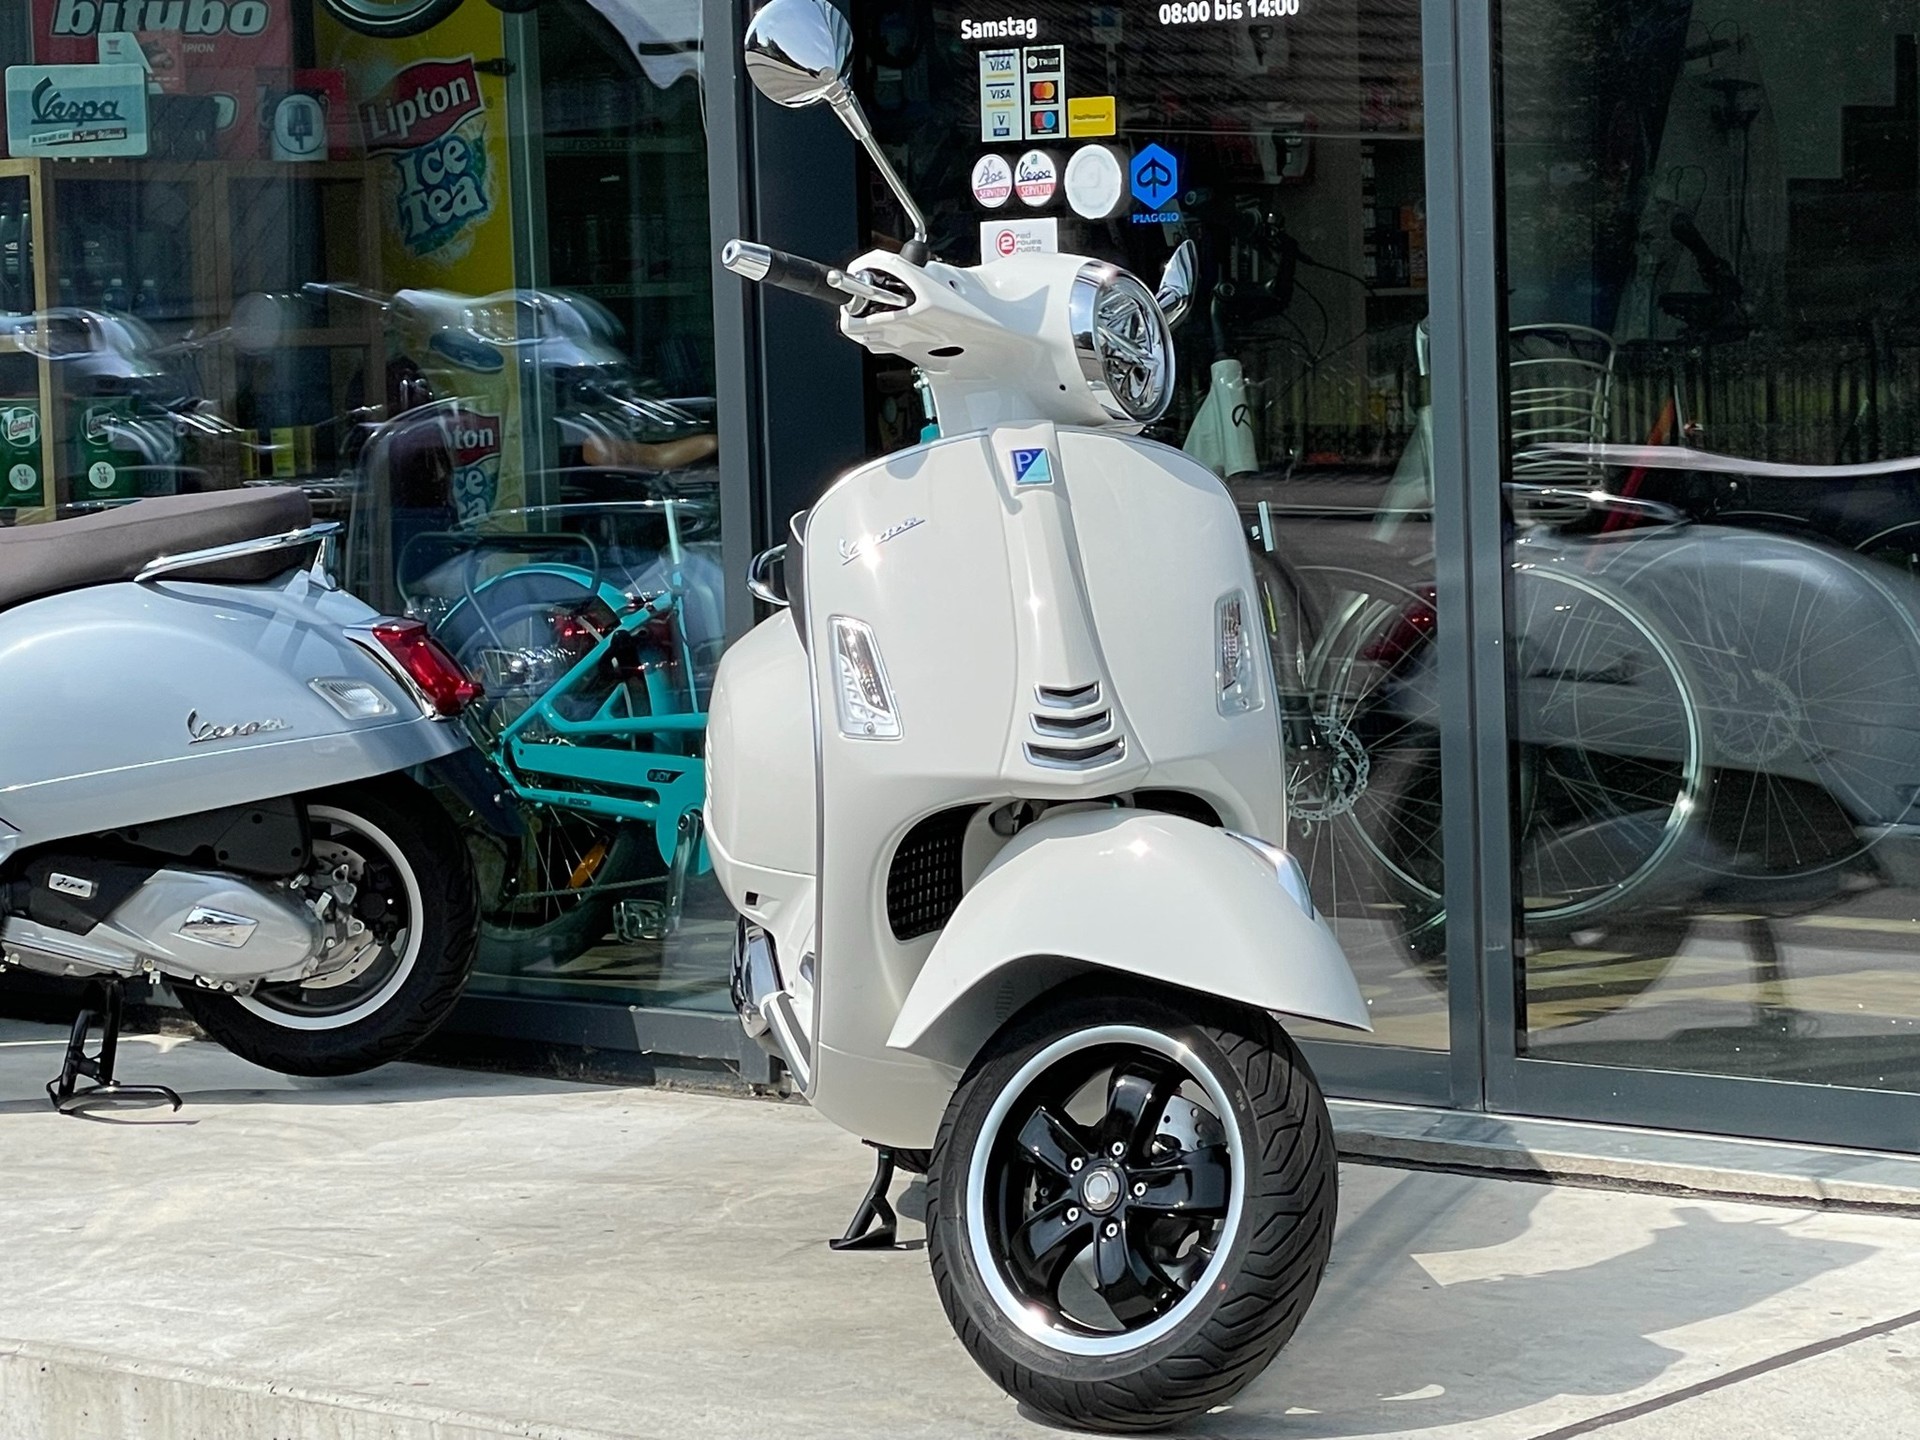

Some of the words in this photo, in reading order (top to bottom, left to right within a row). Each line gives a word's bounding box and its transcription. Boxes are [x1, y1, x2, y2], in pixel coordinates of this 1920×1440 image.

[54, 0, 266, 34] bitubo
[1158, 0, 1210, 25] 08:00
[1214, 0, 1243, 21] bis
[1247, 0, 1299, 18] 14:00
[961, 17, 1037, 39] Samstag
[990, 61, 1011, 71] VISA
[31, 76, 126, 127] Vespa
[990, 89, 1011, 99] VISA
[366, 76, 470, 140] Lipton
[399, 139, 468, 193] Ice
[1018, 161, 1053, 183] Vespa
[1020, 184, 1052, 196] SERVIZIO
[402, 176, 484, 237] Tea
[1133, 212, 1179, 223] PIAGGIO
[187, 708, 293, 744] Vespa
